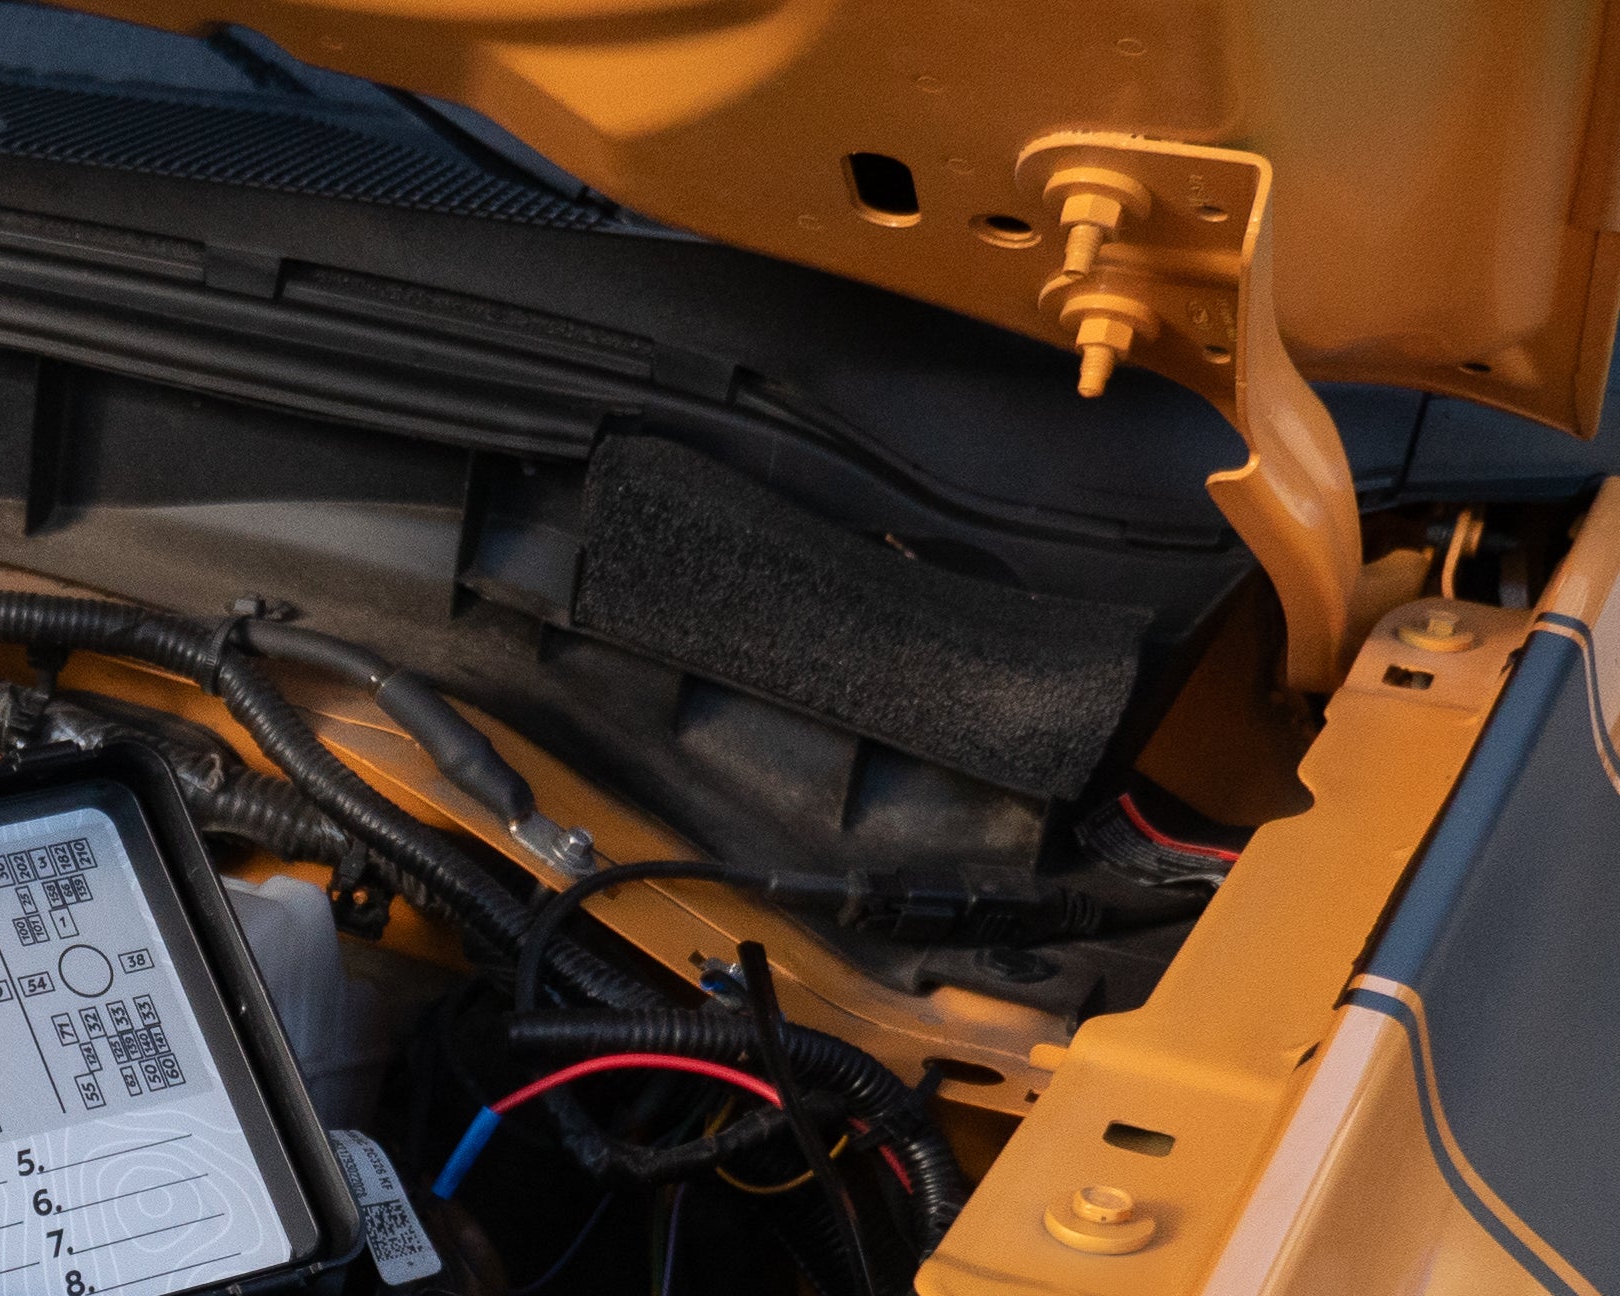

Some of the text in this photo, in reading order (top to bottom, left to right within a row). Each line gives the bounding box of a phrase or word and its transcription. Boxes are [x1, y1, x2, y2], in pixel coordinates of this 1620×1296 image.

[53, 846, 72, 870] 182
[73, 841, 92, 865] 210
[13, 855, 31, 879] 202
[59, 916, 66, 928] 1
[127, 953, 146, 968] 38
[27, 976, 47, 993] 54
[110, 1006, 129, 1026] 33
[136, 1001, 156, 1020] 33
[57, 1022, 74, 1039] 71
[83, 1012, 102, 1032] 32
[144, 1064, 161, 1083] 50
[161, 1058, 179, 1079] 60
[81, 1082, 100, 1101] 55
[17, 1148, 46, 1176] 5.
[32, 1188, 65, 1216] 6.
[46, 1228, 76, 1258] 7.
